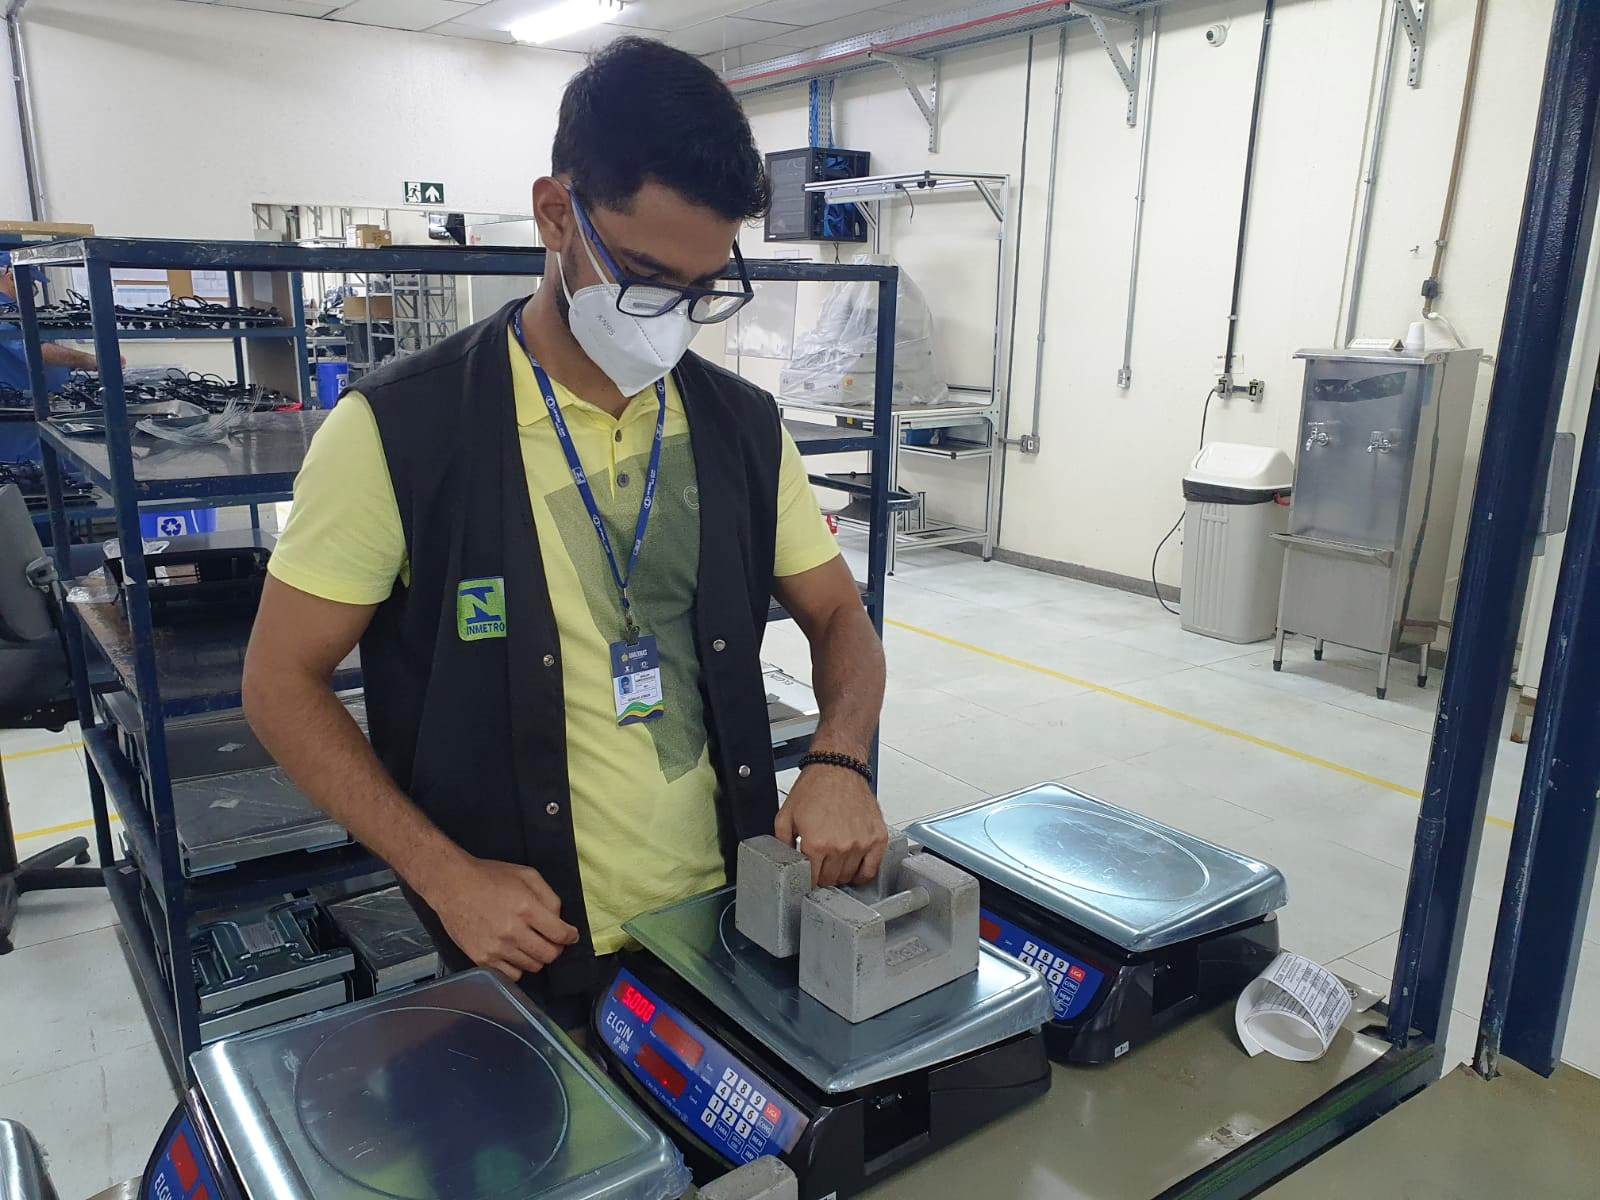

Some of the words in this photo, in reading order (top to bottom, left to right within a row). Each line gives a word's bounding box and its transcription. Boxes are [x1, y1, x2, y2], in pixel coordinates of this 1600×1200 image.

[466, 622, 505, 636] INMETRO
[606, 1011, 634, 1042] ELGIN
[727, 1072, 734, 1081] 7
[740, 1083, 748, 1094] 8
[754, 1095, 762, 1106] 9
[719, 1086, 727, 1096] 4
[733, 1097, 740, 1108] 5
[746, 1110, 754, 1120] 6
[705, 1113, 713, 1123] 0
[725, 1110, 733, 1122] 2
[739, 1123, 747, 1132] 3
